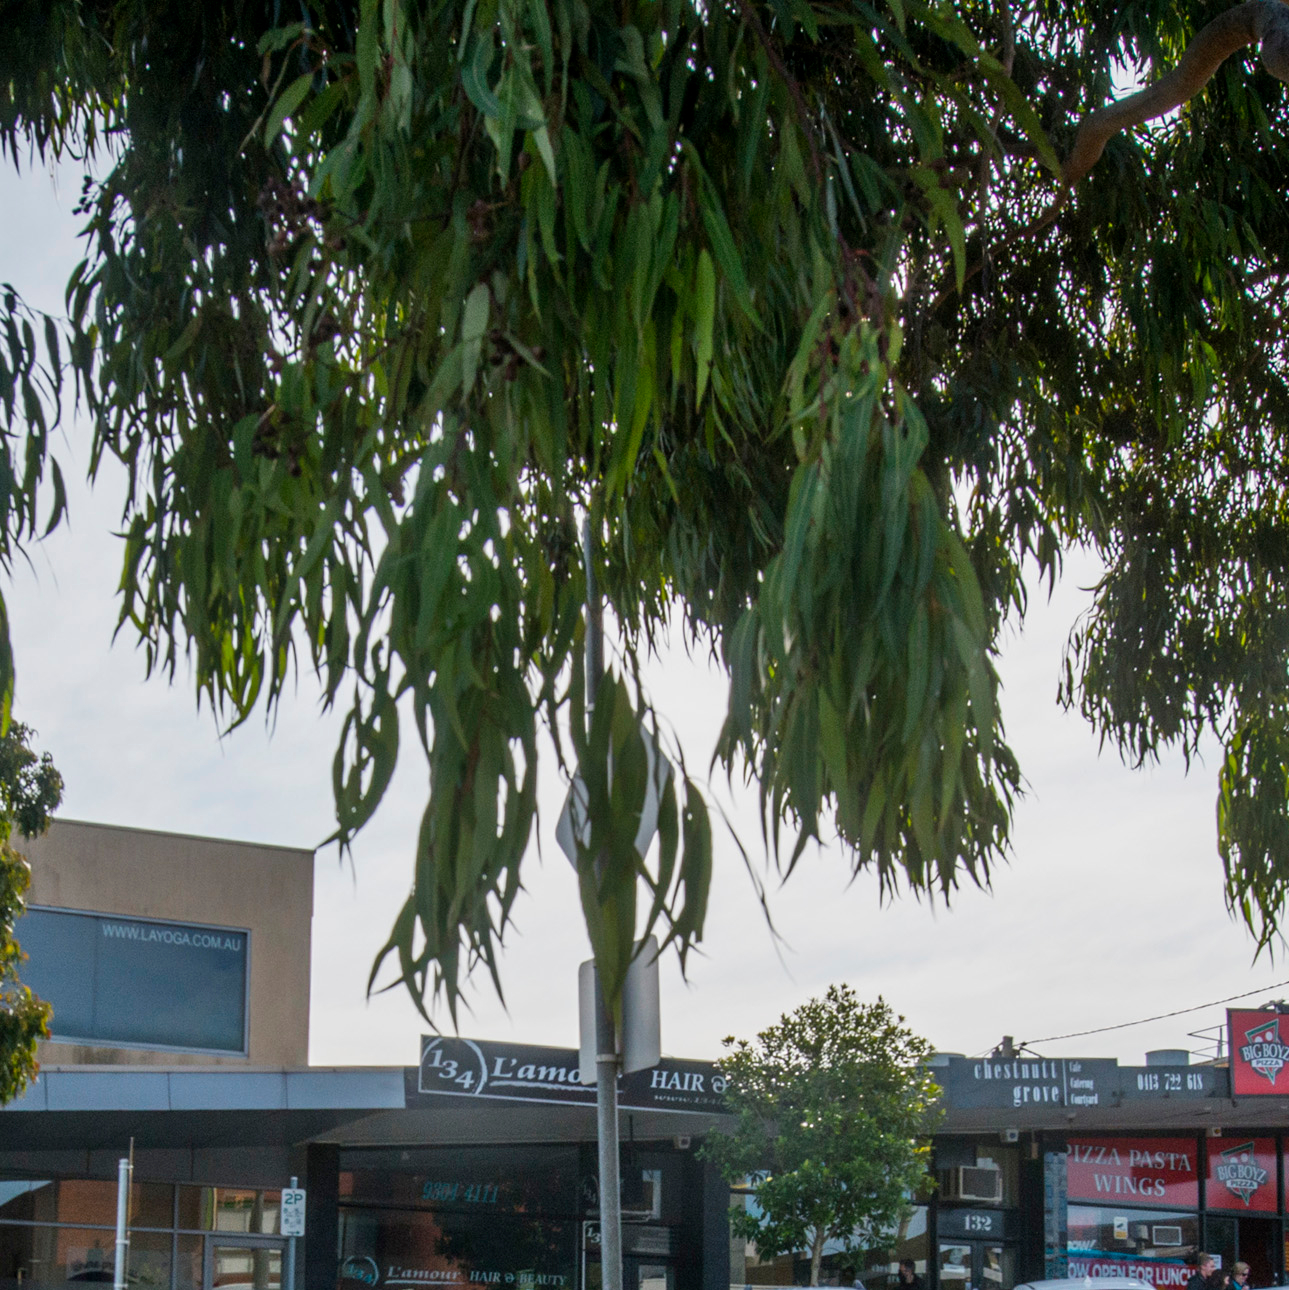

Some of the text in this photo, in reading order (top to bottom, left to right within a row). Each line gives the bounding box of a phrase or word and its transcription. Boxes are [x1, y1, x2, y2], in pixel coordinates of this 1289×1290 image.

[102, 924, 241, 951] WWW.LAYOGA.COM.AU
[1243, 1045, 1262, 1061] BIG
[974, 1059, 1058, 1080] chestnutt
[650, 1070, 705, 1092] HAIR
[1137, 1073, 1203, 1090] 0413 722 618
[1013, 1085, 1059, 1107] grove
[1129, 1149, 1192, 1172] PASTA
[1093, 1173, 1166, 1197] WINGS
[1217, 1165, 1267, 1185] BIG BOYZ
[1232, 1180, 1255, 1188] PIZZA
[284, 1192, 303, 1205] 2P
[964, 1214, 992, 1231] 132
[386, 1266, 462, 1280] L'amour
[470, 1271, 501, 1283] HAIR
[519, 1272, 568, 1286] BEAUTY
[1092, 1264, 1125, 1278] OPEN
[1128, 1265, 1153, 1284] FOR
